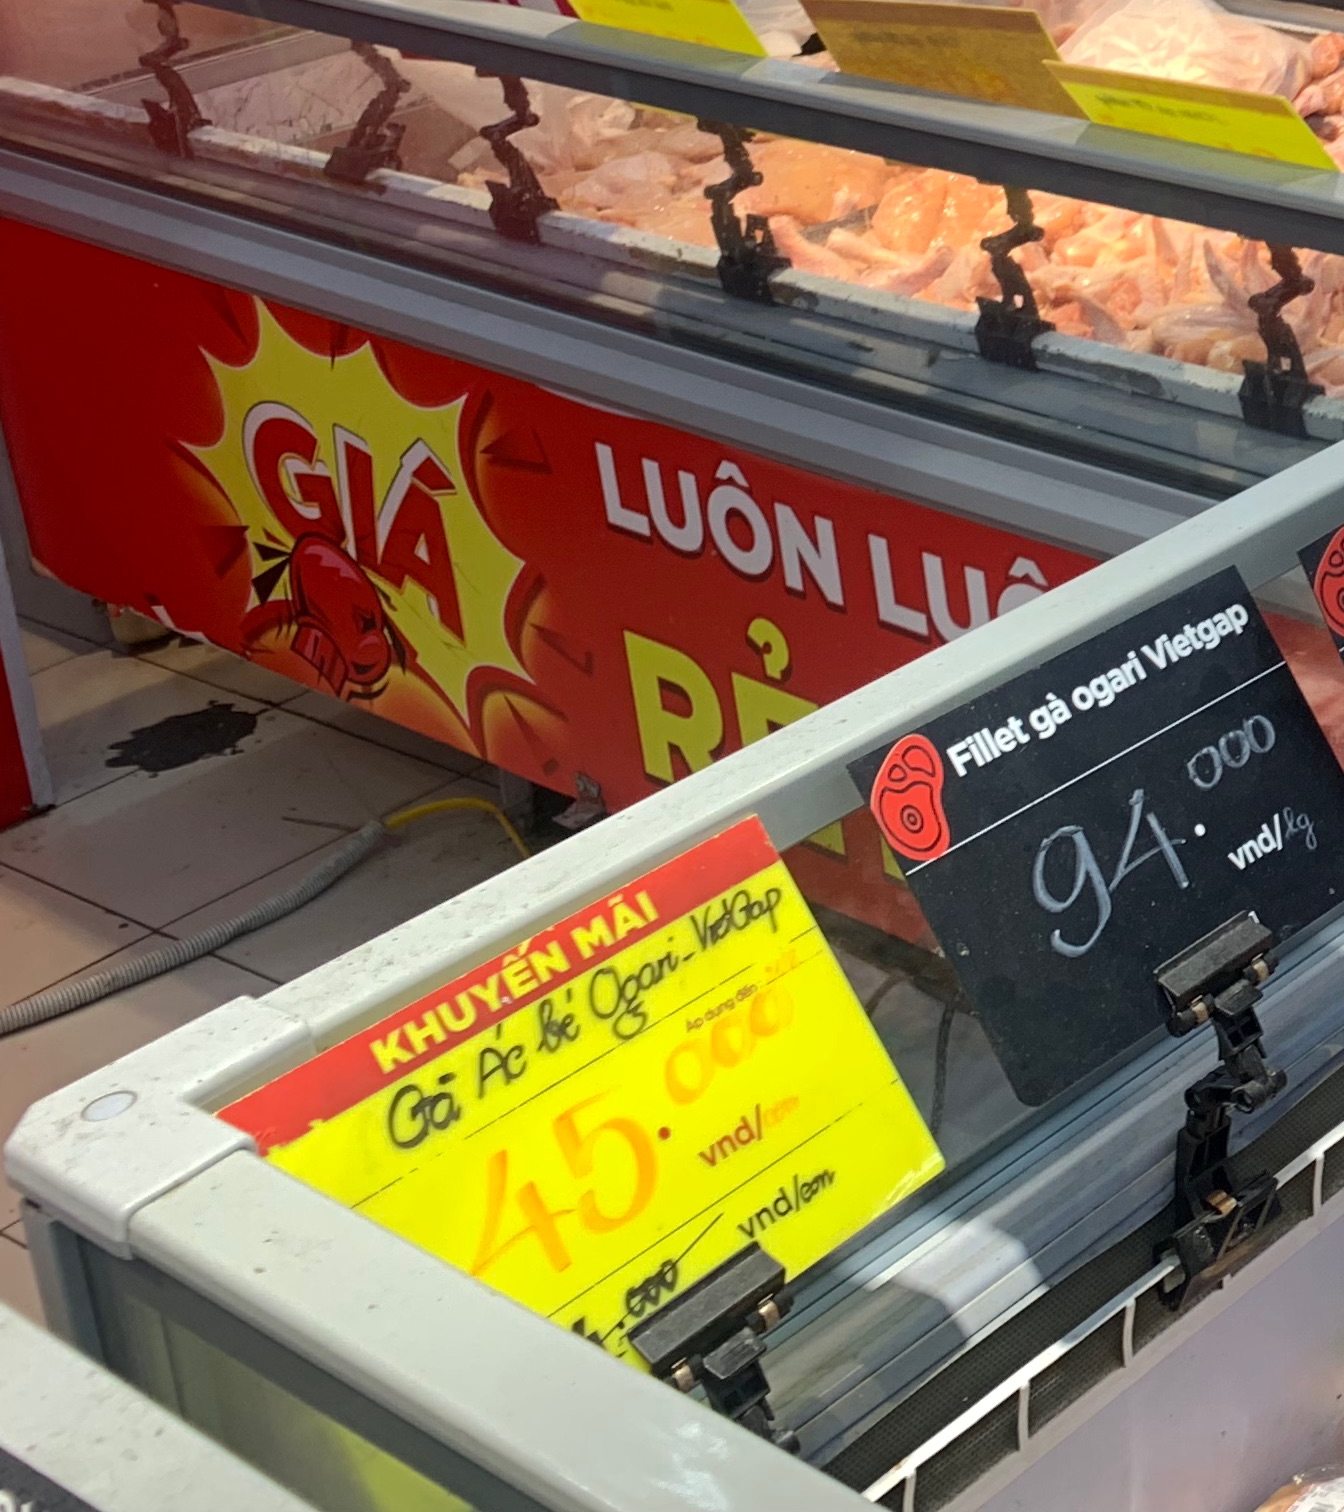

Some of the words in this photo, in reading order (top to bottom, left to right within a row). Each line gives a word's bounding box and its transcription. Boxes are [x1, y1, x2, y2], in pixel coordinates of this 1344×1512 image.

[242, 400, 466, 644] GIÁ
[594, 440, 847, 608] LUÔN
[867, 535, 1050, 645] LUÔ
[947, 715, 1030, 778] Fillet
[1028, 693, 1073, 736] gà
[1071, 652, 1147, 713] ogari
[1142, 601, 1250, 671] Vietgap
[370, 935, 569, 1076] KHUYẾN
[576, 890, 662, 951] MÃI
